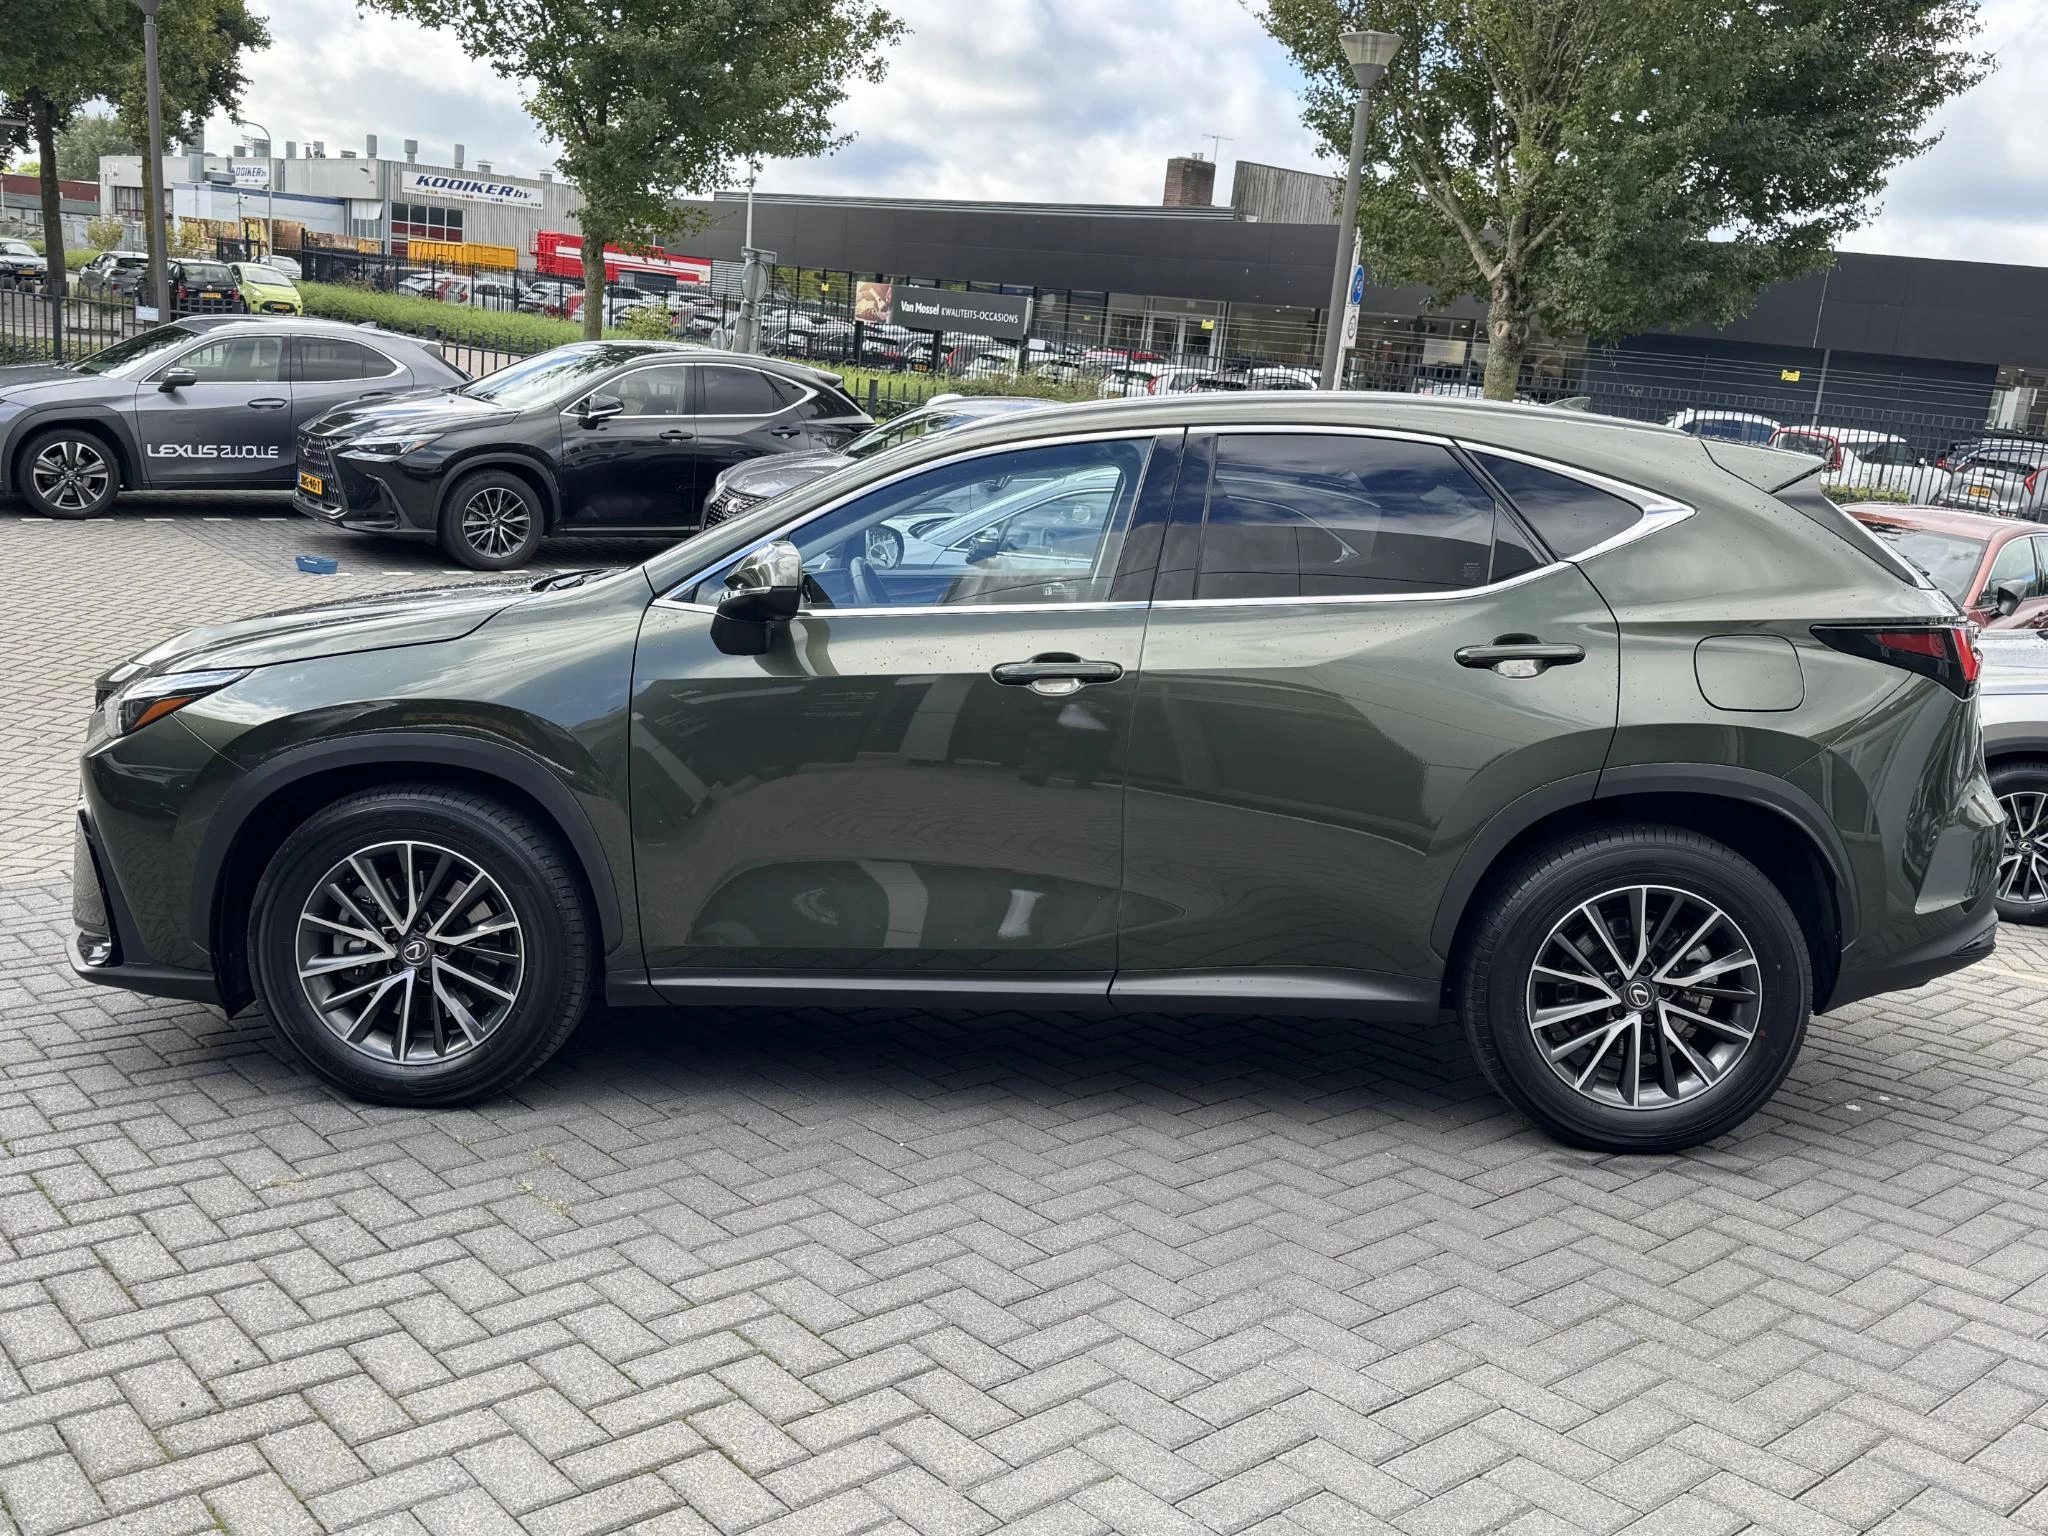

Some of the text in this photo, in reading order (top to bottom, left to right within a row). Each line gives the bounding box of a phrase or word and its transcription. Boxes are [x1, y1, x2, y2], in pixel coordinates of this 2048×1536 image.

[901, 300, 1018, 324] Van Mossel KWALITEITS-OCCASIONS
[147, 443, 279, 459] LEXUS ZWOLLE
